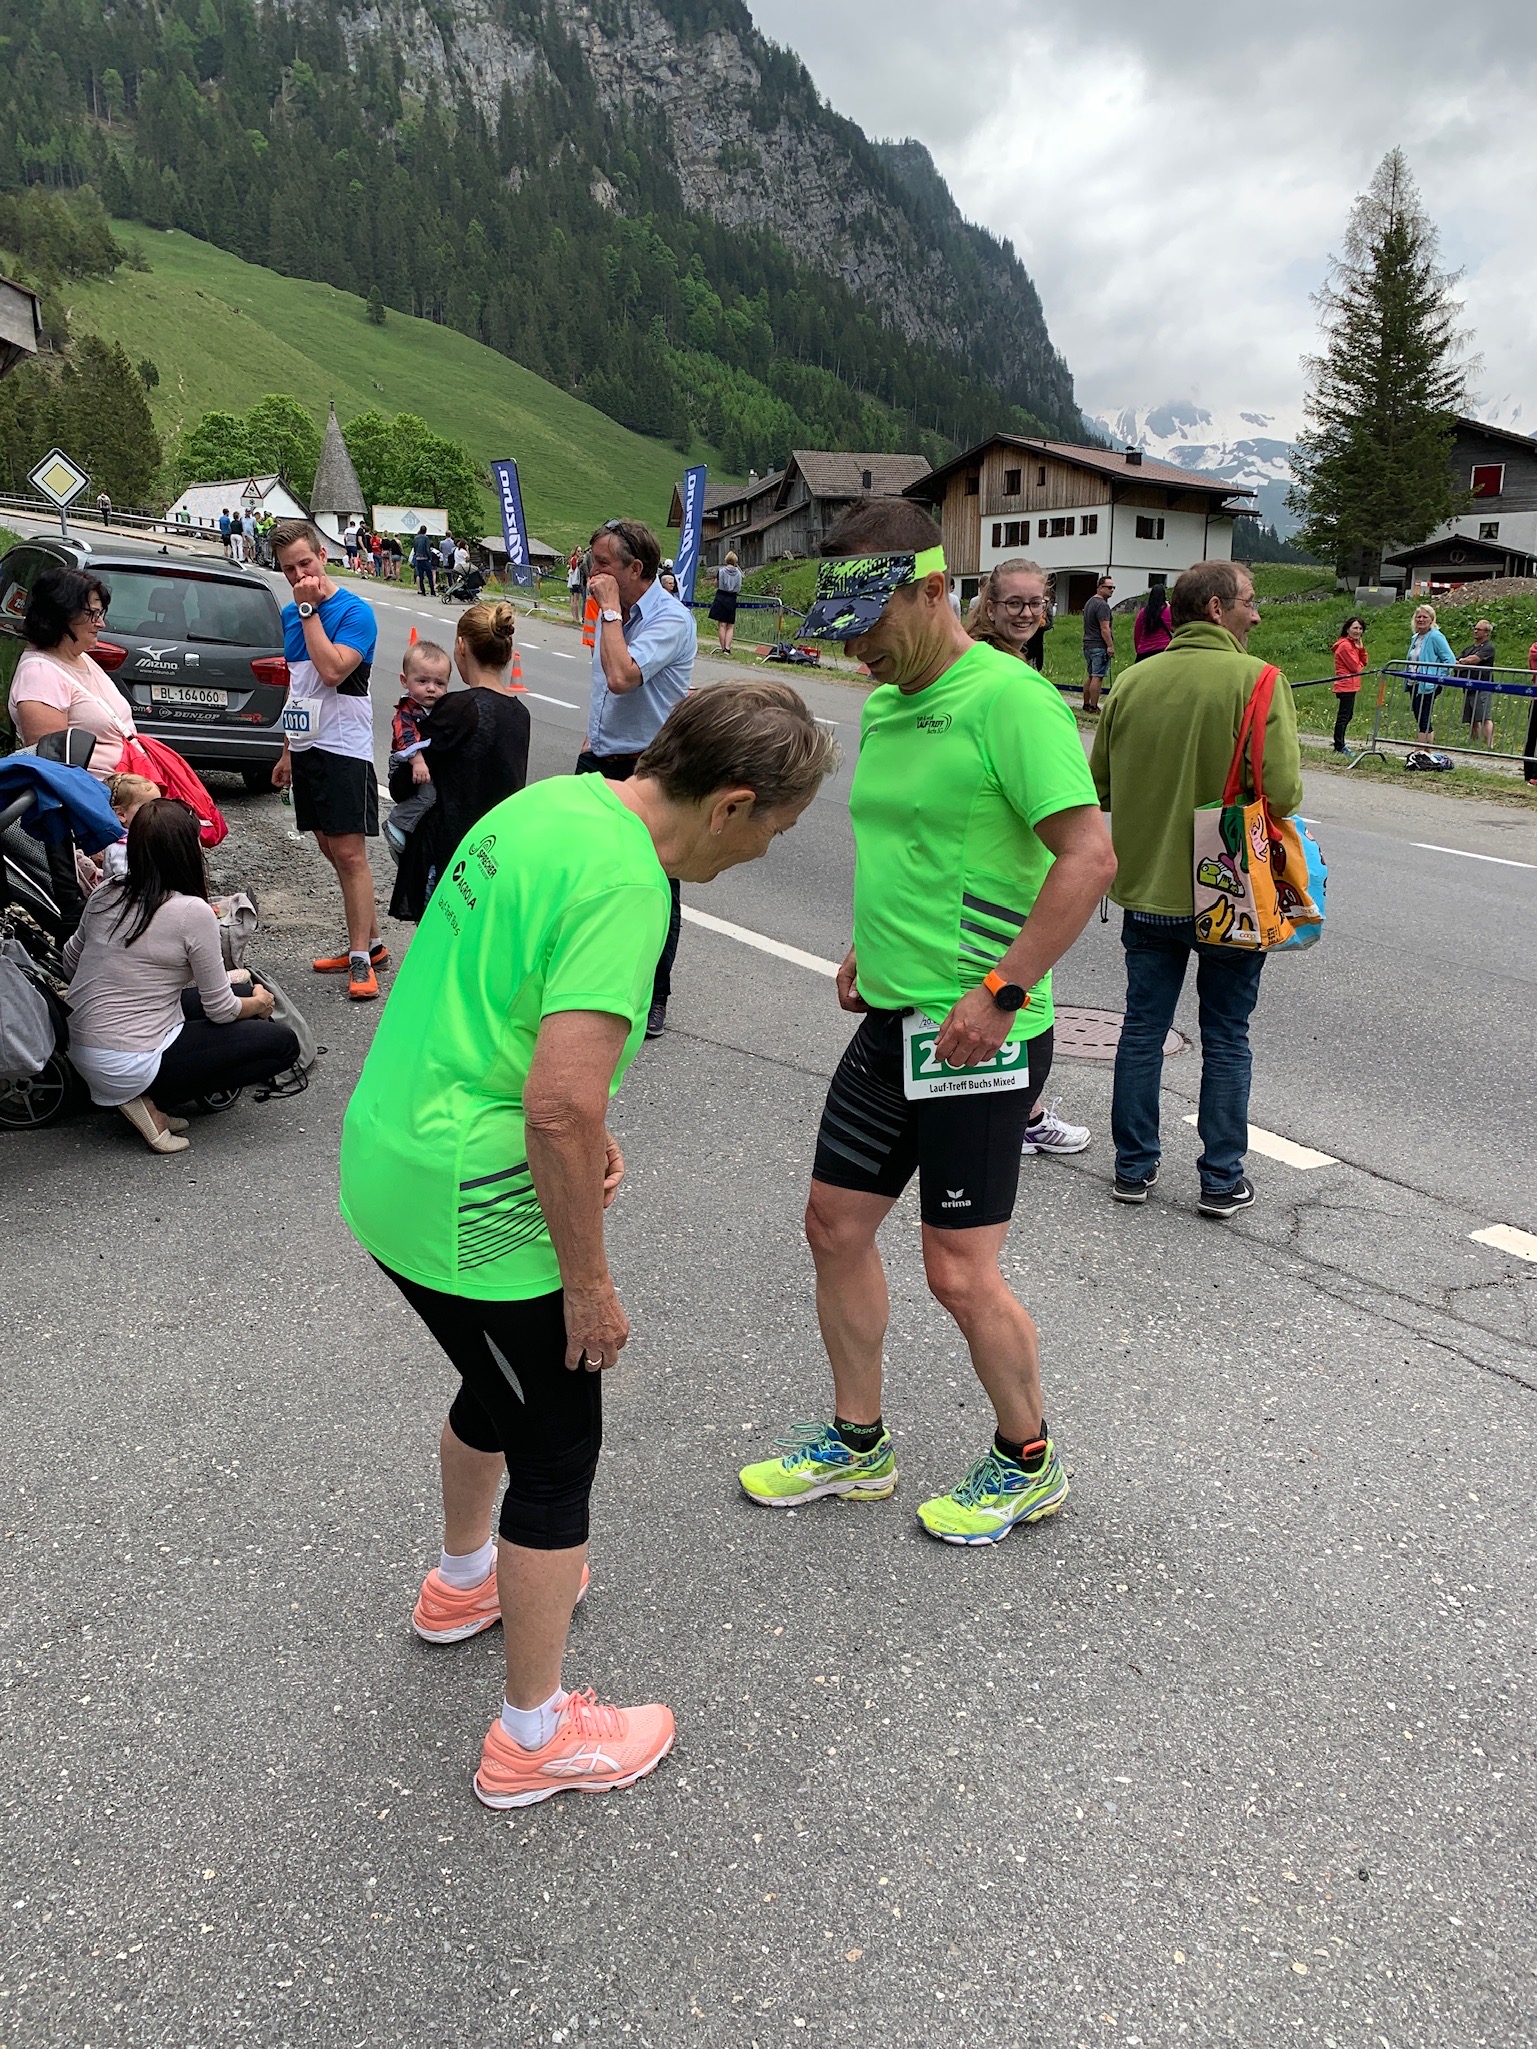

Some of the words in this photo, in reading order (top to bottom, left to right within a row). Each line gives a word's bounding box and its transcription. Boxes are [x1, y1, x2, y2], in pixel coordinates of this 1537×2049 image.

[173, 711, 220, 720] DUNLOP
[284, 713, 307, 730] 1010
[457, 878, 477, 910] AGROLA
[929, 1081, 967, 1093] Lauf-Treff
[968, 1078, 992, 1089] Buchs
[993, 1076, 1016, 1087] Mixed
[941, 1200, 972, 1208] erima
